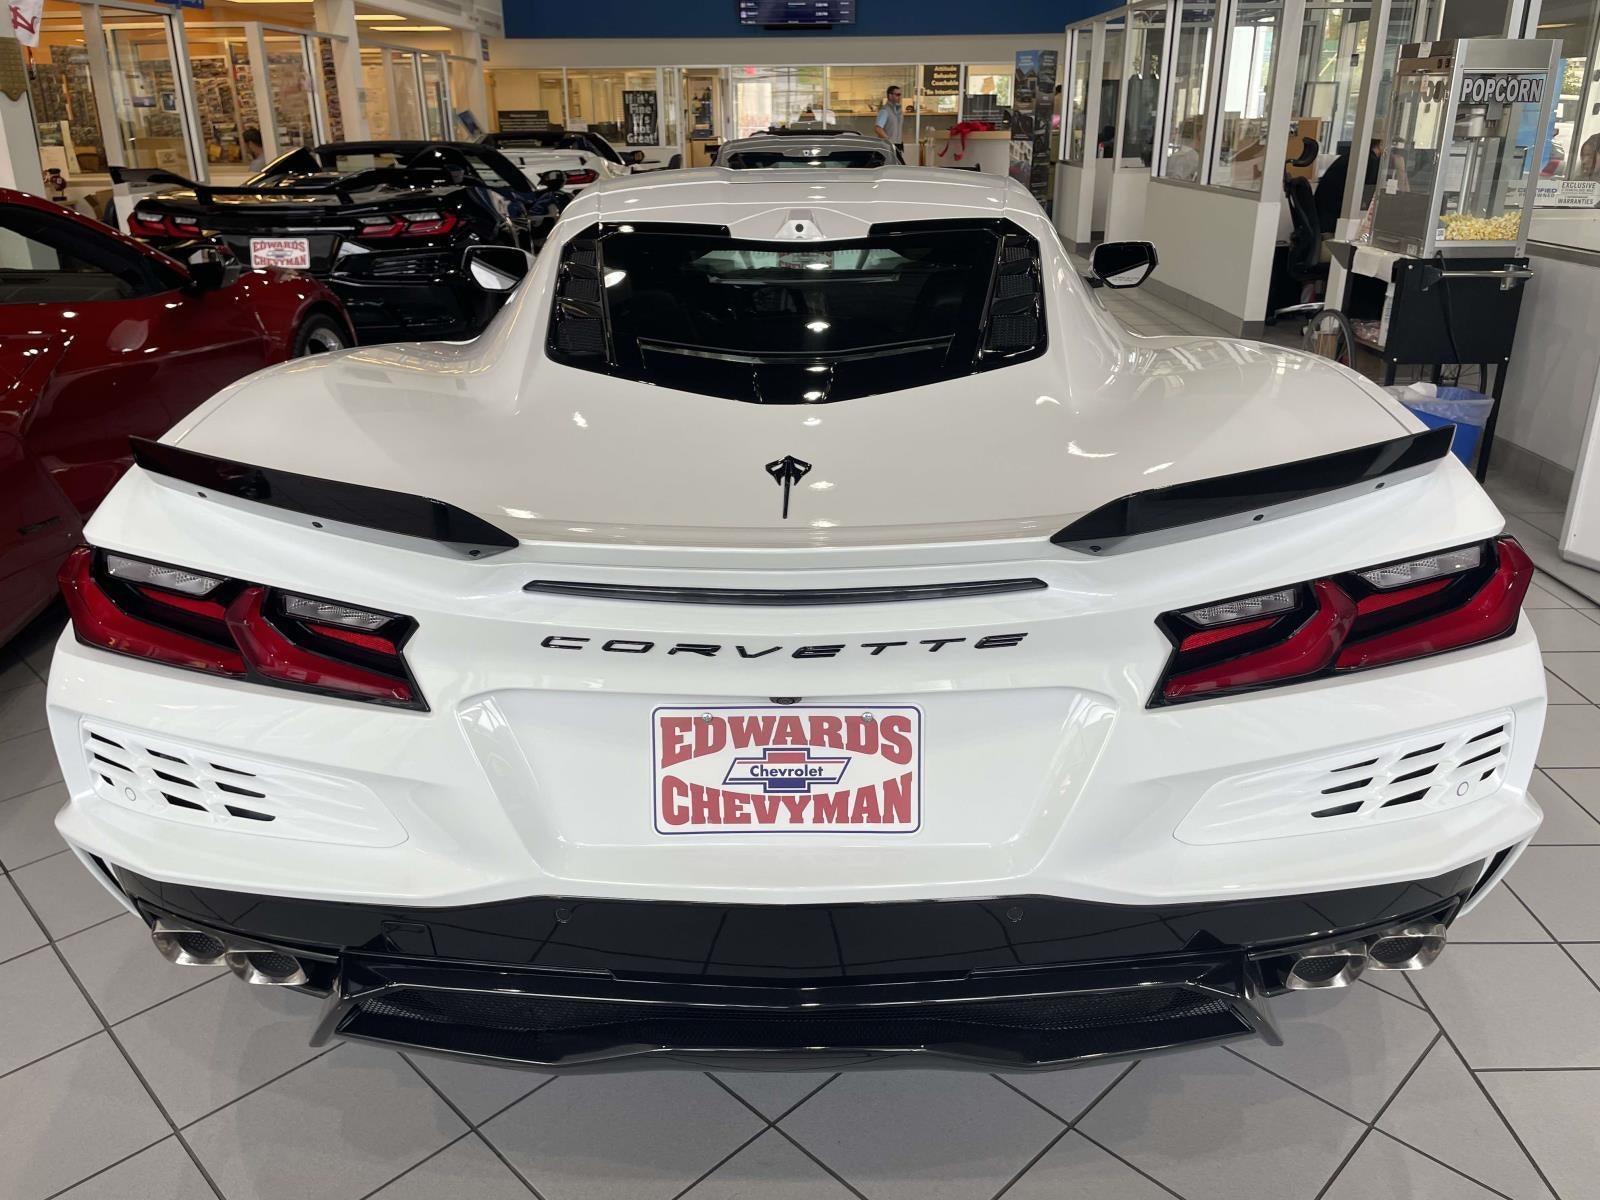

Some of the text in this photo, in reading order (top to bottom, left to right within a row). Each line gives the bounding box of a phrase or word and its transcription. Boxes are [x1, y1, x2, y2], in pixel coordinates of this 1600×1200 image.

[1460, 77, 1544, 103] POPCORN
[627, 132, 657, 144] Great!
[1561, 181, 1596, 189] EXCLUSIVE
[253, 241, 305, 252] EDWARDS
[540, 632, 1029, 659] CORVETTE
[660, 715, 913, 769] EDWARDS
[749, 764, 824, 778] Chevrolet
[661, 771, 913, 826] CHEVYMAN
